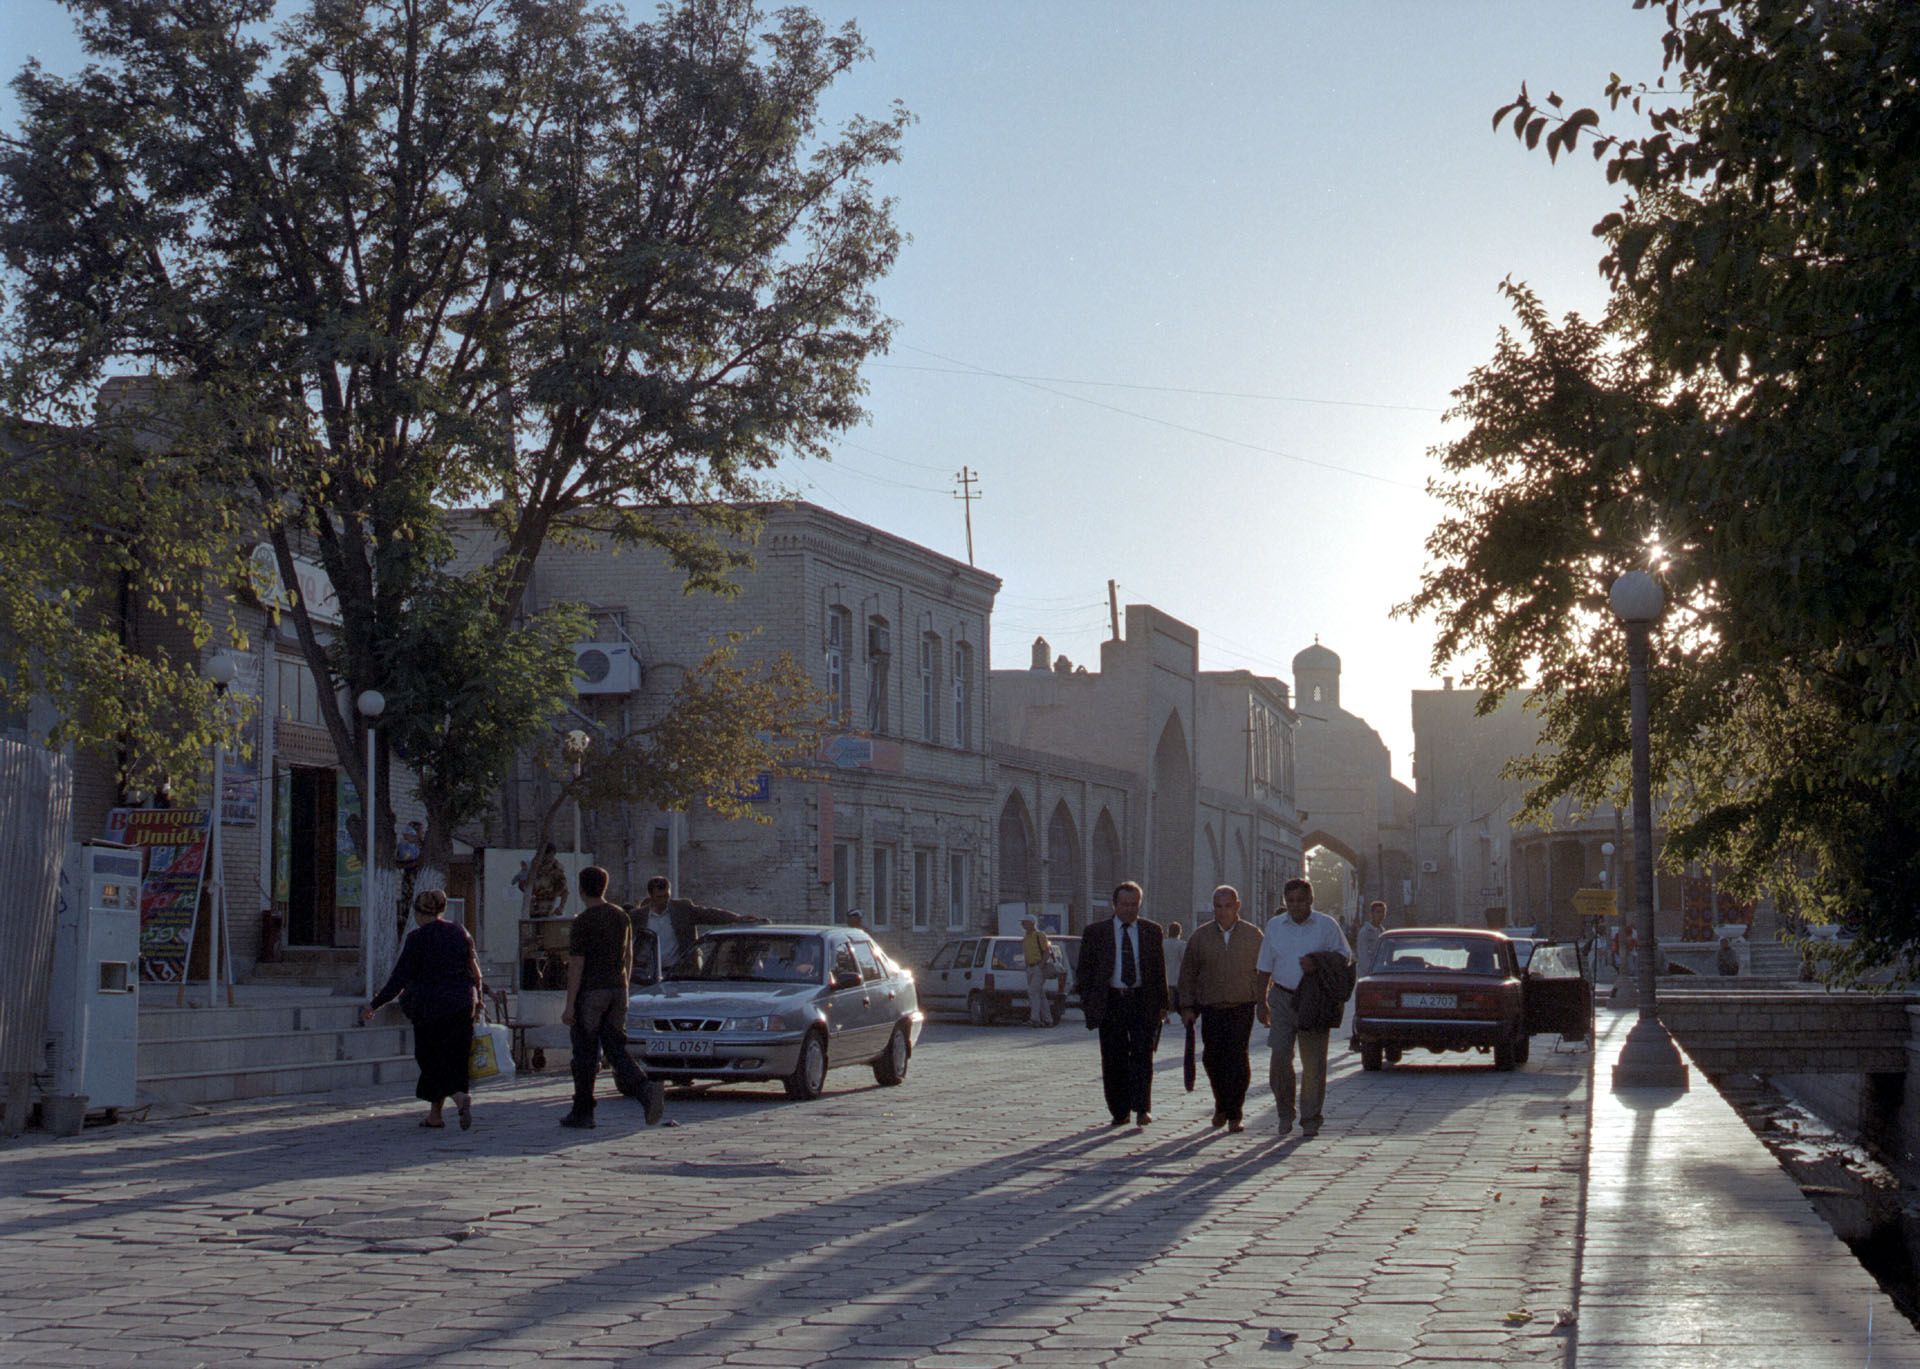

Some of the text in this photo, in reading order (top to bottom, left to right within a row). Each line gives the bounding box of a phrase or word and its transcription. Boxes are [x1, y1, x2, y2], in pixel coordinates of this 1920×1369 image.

[110, 811, 204, 830] BOUTIQUE
[136, 828, 201, 844] UmidA
[651, 1040, 709, 1052] 20 L 0767
